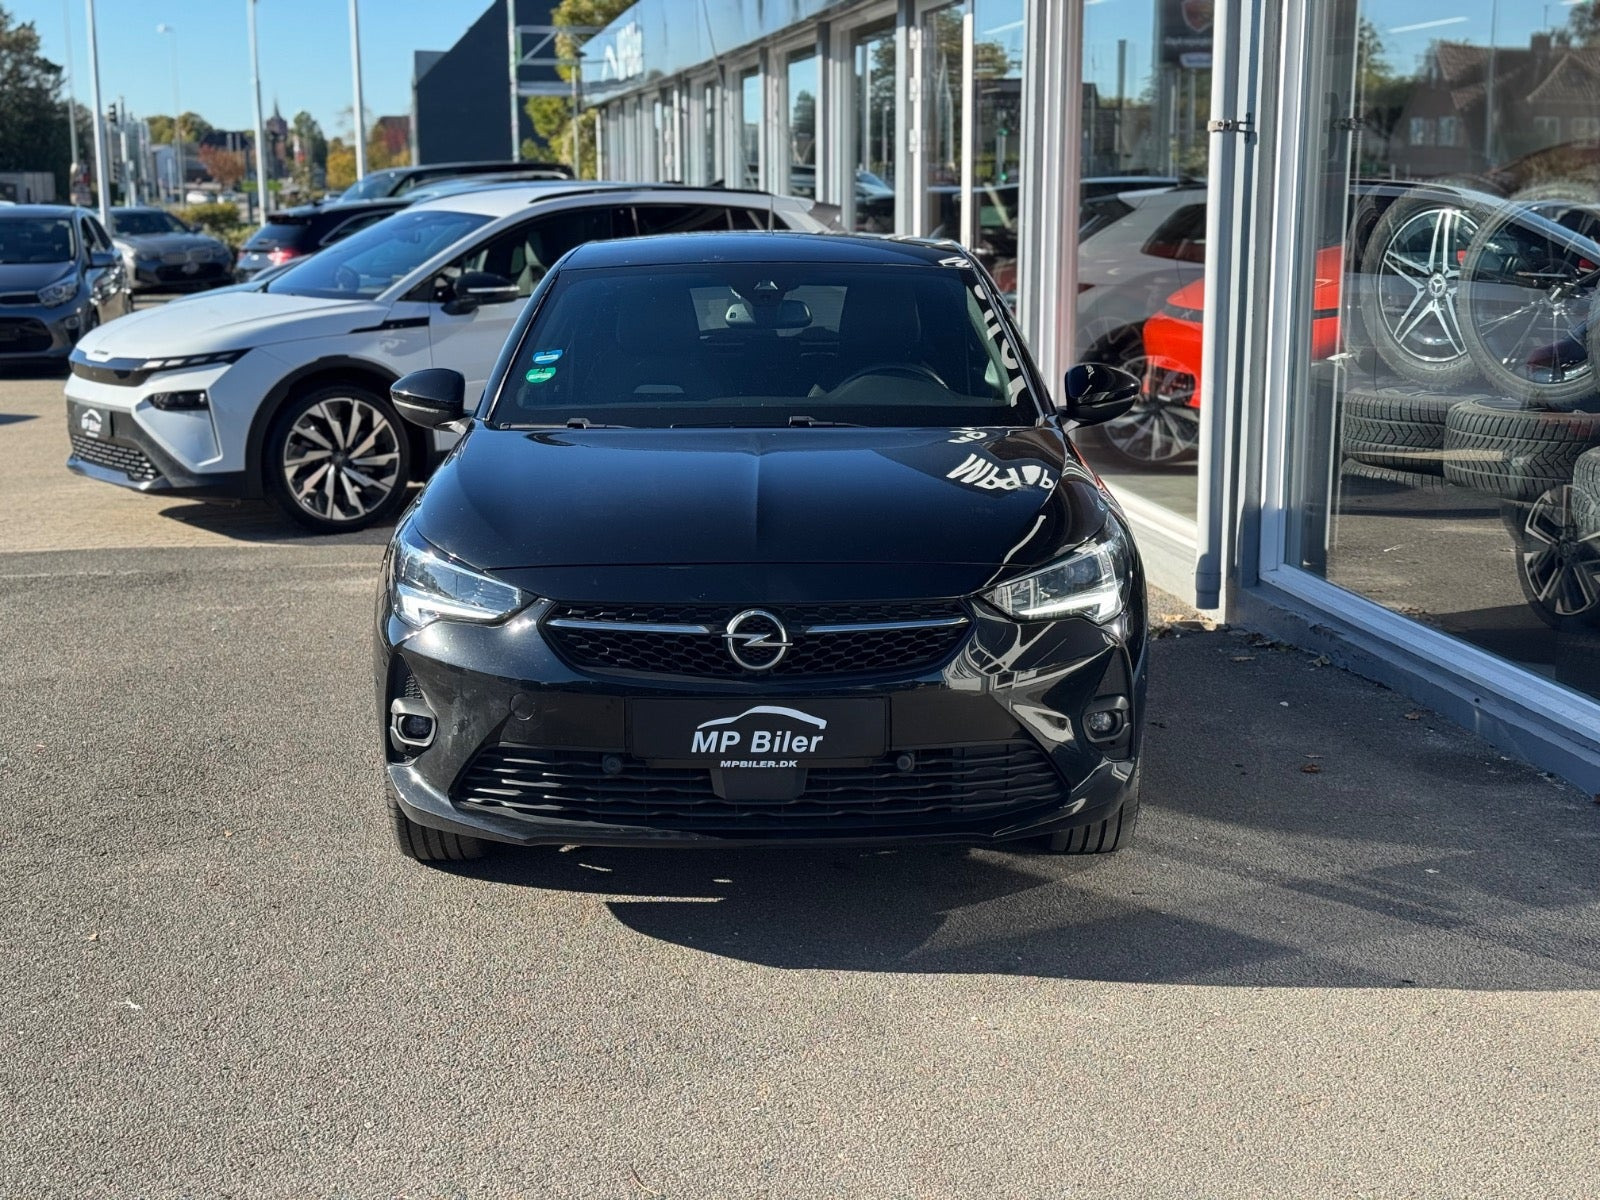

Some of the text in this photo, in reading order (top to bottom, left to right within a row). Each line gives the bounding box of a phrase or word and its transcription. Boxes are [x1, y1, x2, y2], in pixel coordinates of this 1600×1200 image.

[691, 731, 824, 753] MP Biler
[720, 760, 798, 768] MPBILER.DK
